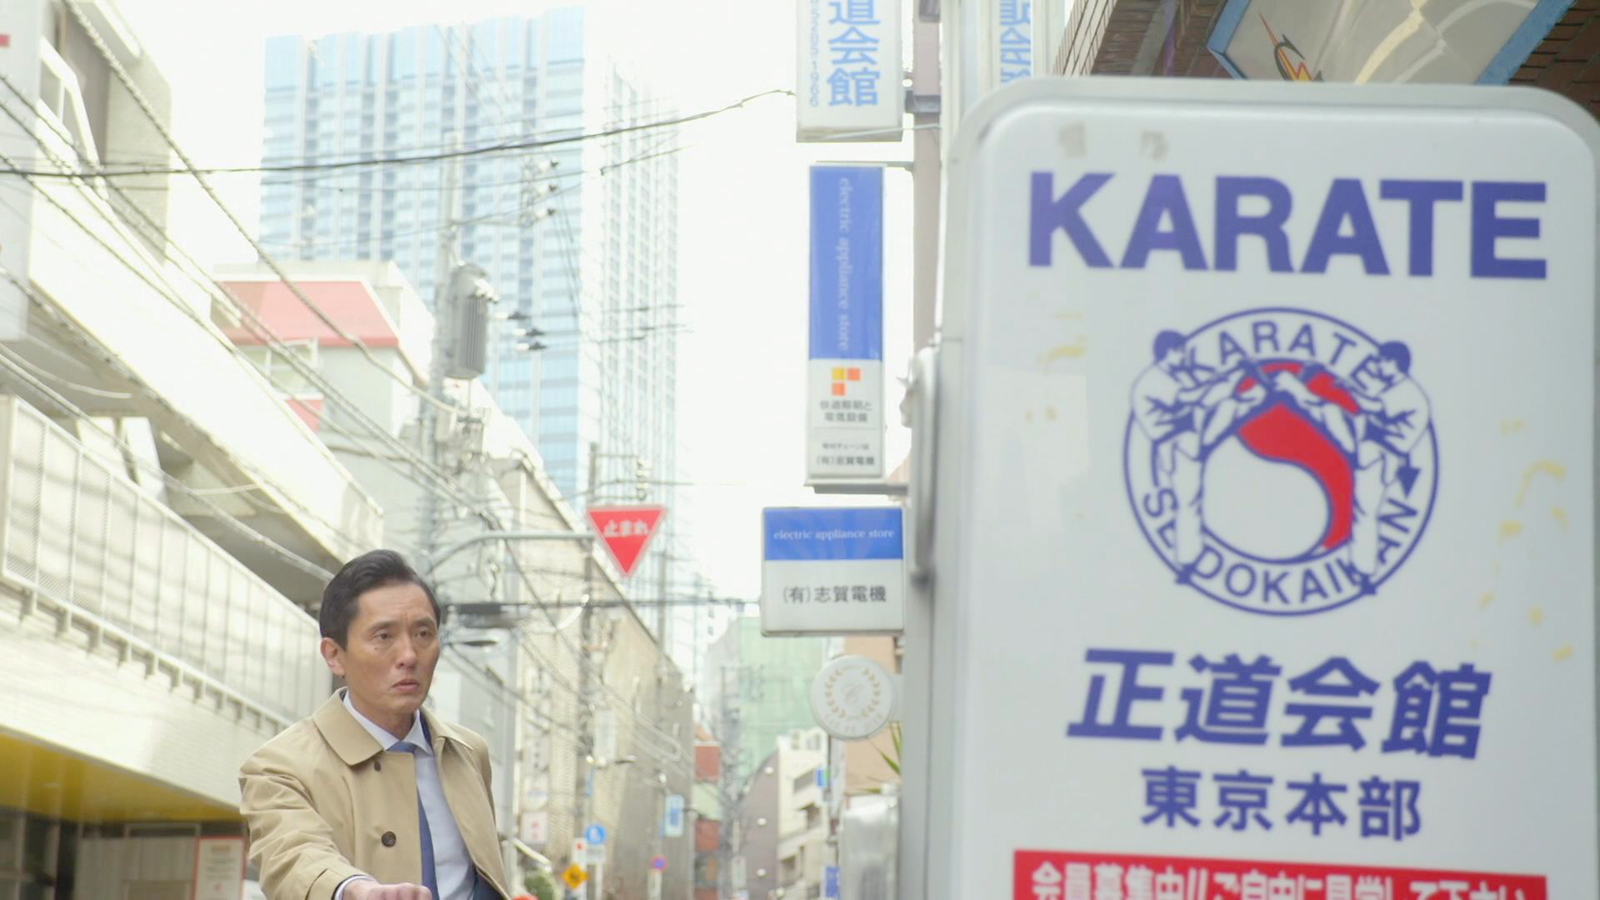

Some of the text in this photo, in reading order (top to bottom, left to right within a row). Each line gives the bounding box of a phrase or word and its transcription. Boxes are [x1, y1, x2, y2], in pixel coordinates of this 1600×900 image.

[1028, 171, 1547, 279] KARATE
[836, 177, 852, 351] electric appliance store
[1170, 321, 1392, 394] KARATE
[603, 520, 649, 538] 止まれ
[773, 528, 895, 541] electric appliance store
[783, 585, 888, 604] (有)志賀電機
[1066, 648, 1492, 760] 正道会館
[1140, 765, 1422, 842] 東京本部
